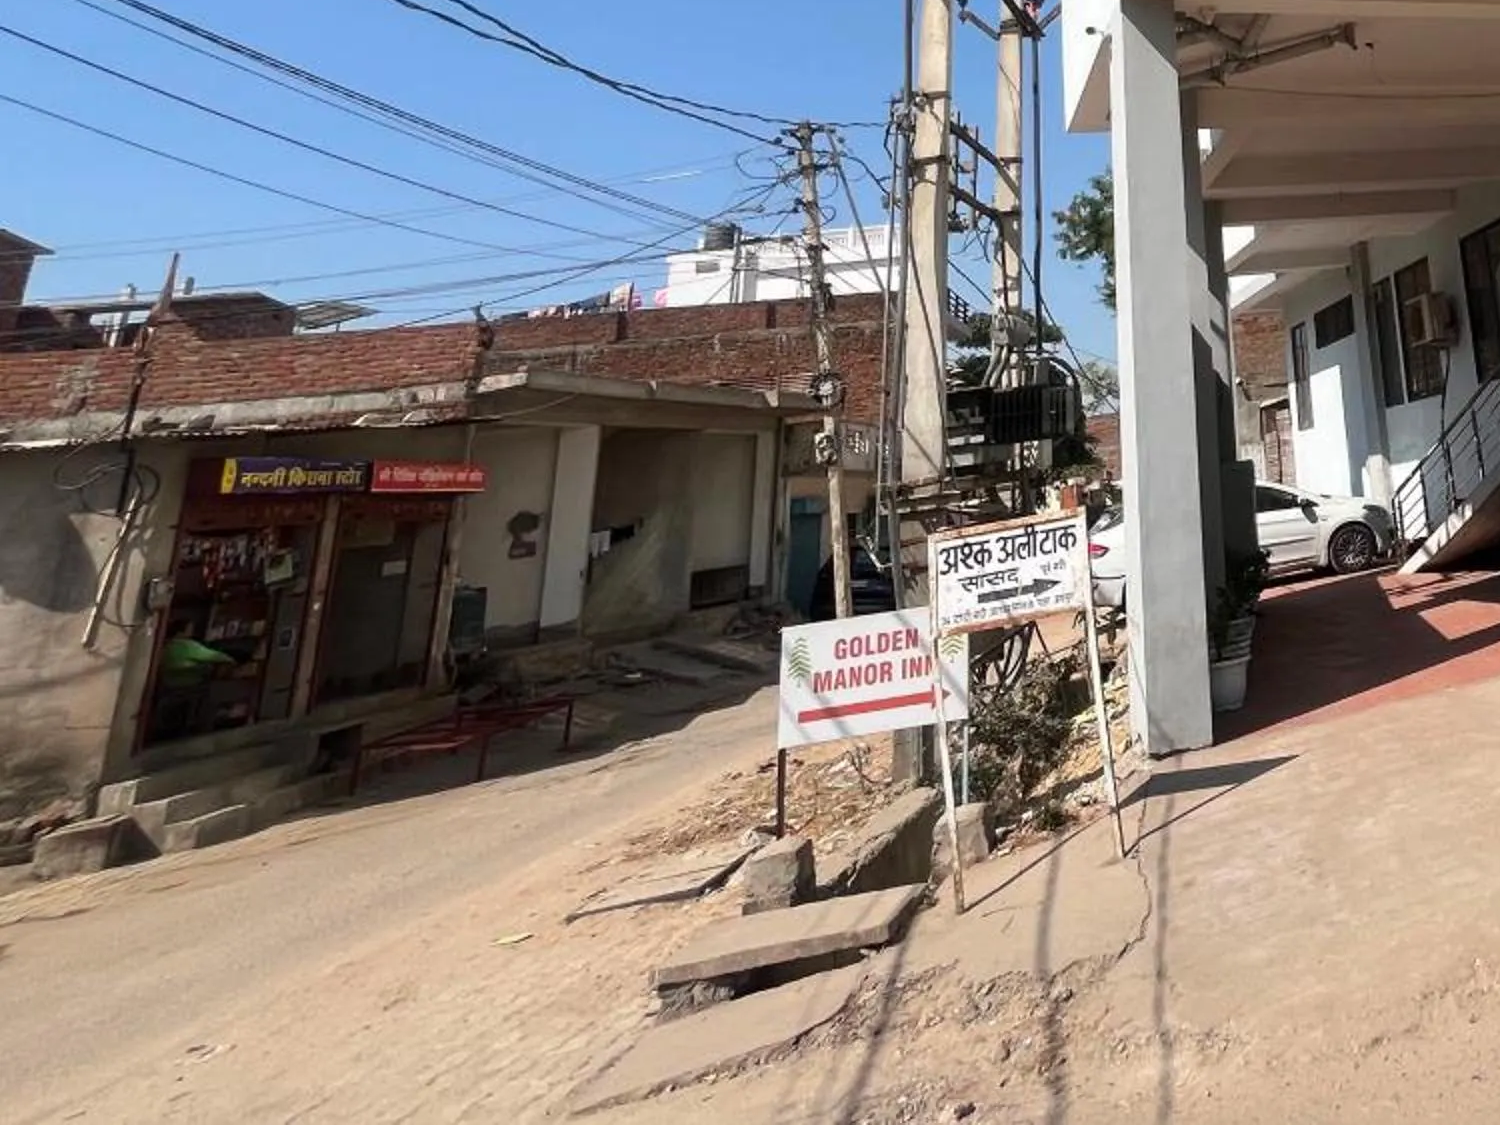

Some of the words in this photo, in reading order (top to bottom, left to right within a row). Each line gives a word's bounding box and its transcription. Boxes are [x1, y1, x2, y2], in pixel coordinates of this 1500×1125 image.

[939, 539, 993, 576] अश्क
[834, 628, 919, 660] GOLDEN
[813, 661, 893, 694] MANOR
[901, 655, 935, 679] INN
